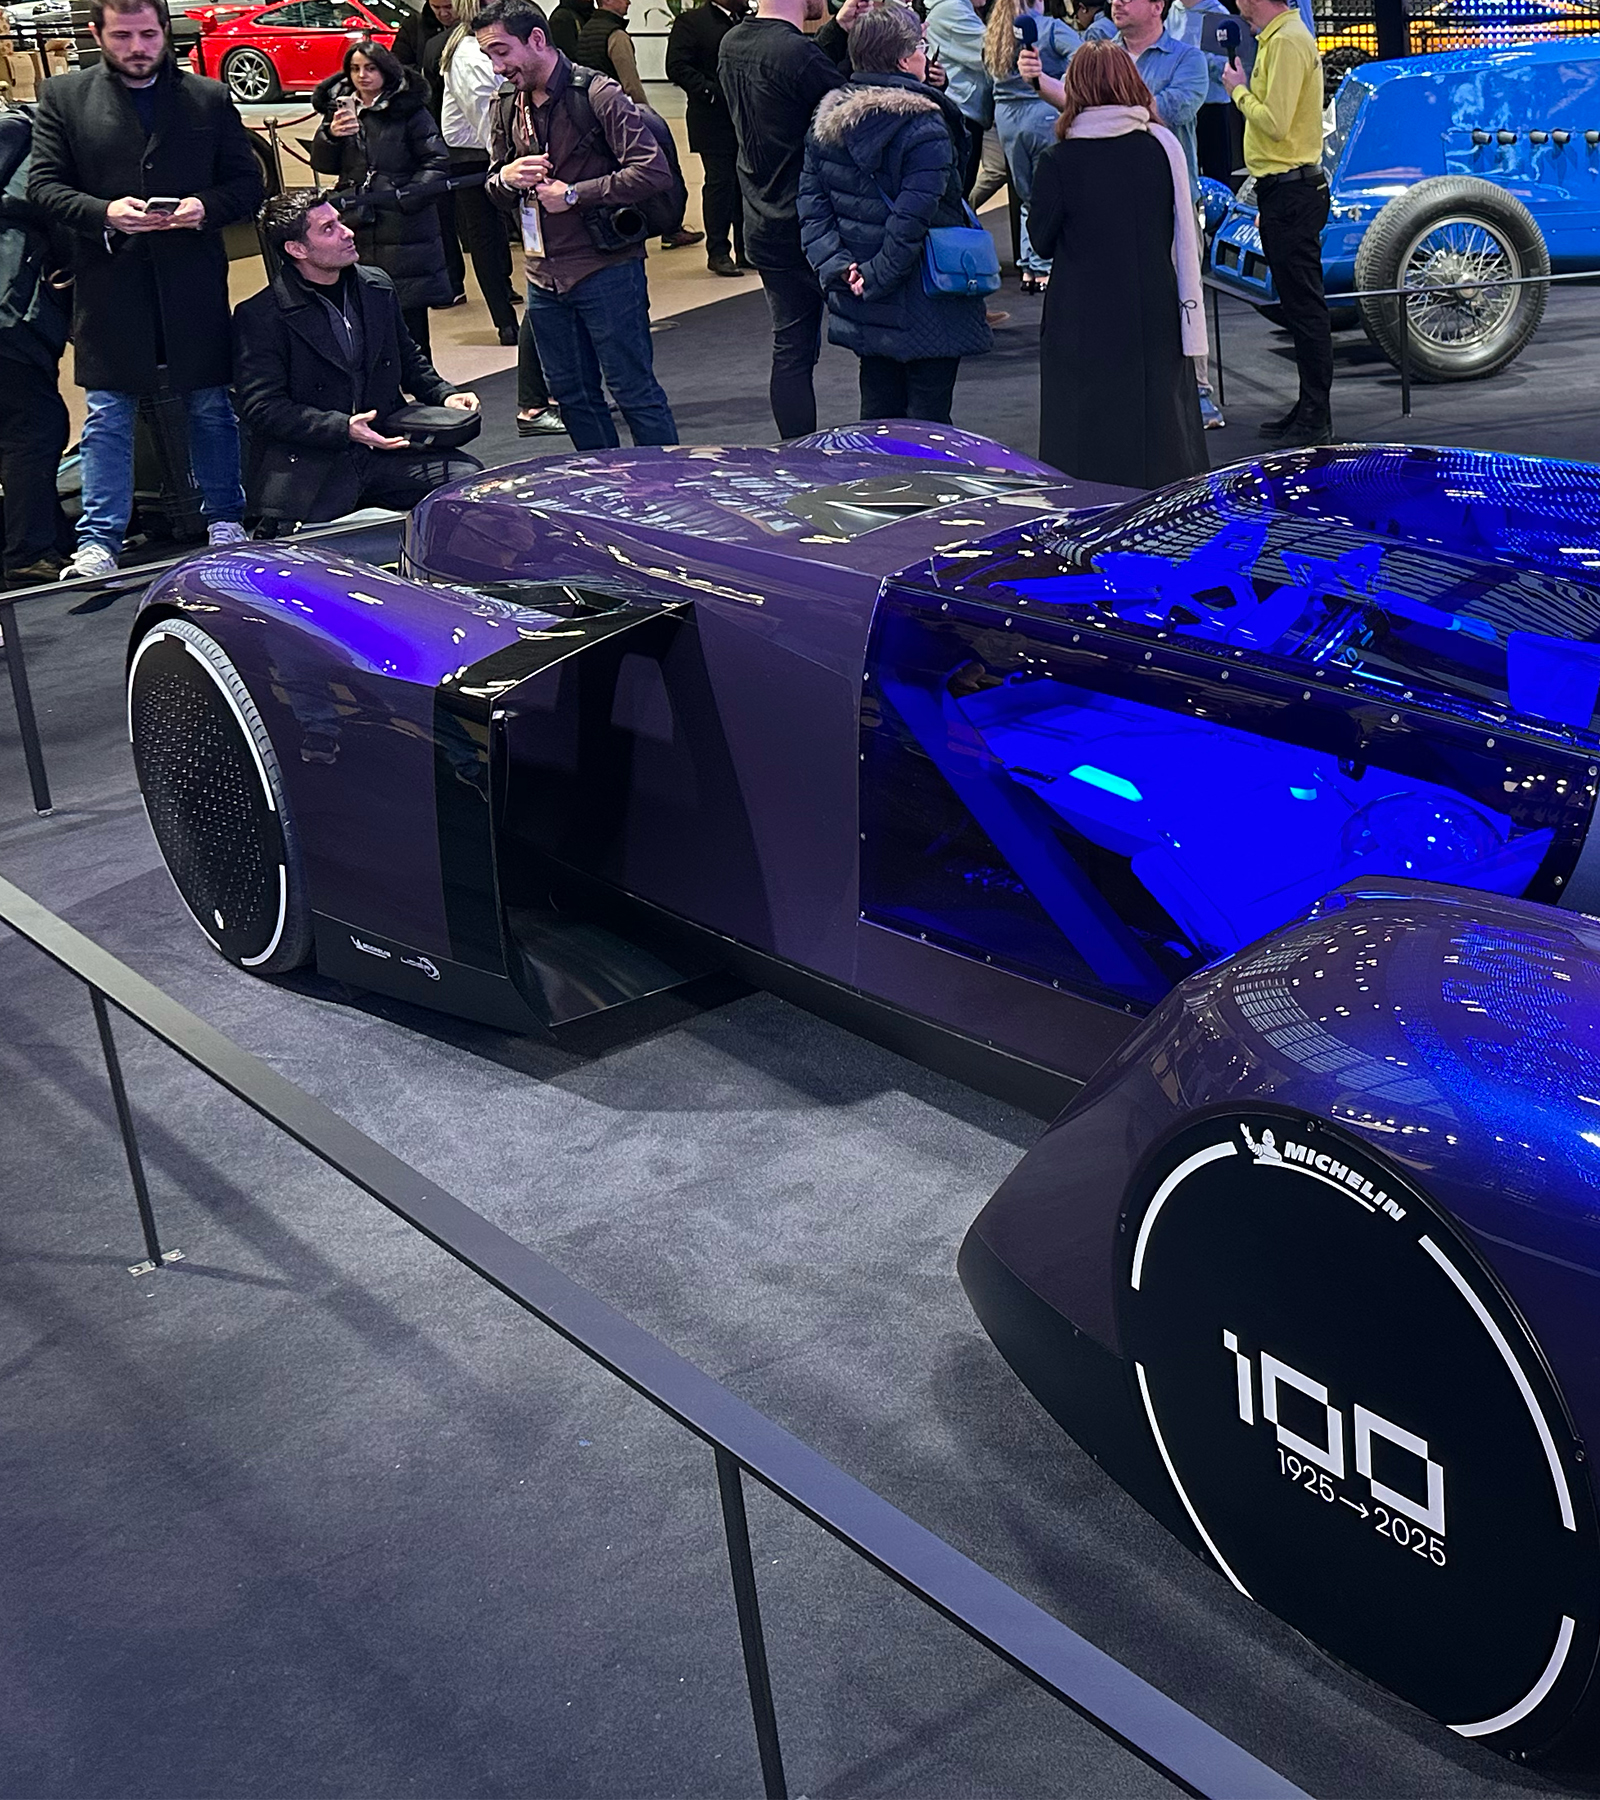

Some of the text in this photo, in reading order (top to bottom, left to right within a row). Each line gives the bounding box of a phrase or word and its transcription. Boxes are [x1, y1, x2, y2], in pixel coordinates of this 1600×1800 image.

[1283, 1140, 1407, 1221] MICHELIN
[1223, 1328, 1446, 1537] 100
[1276, 1447, 1446, 1567] 1925 2025
